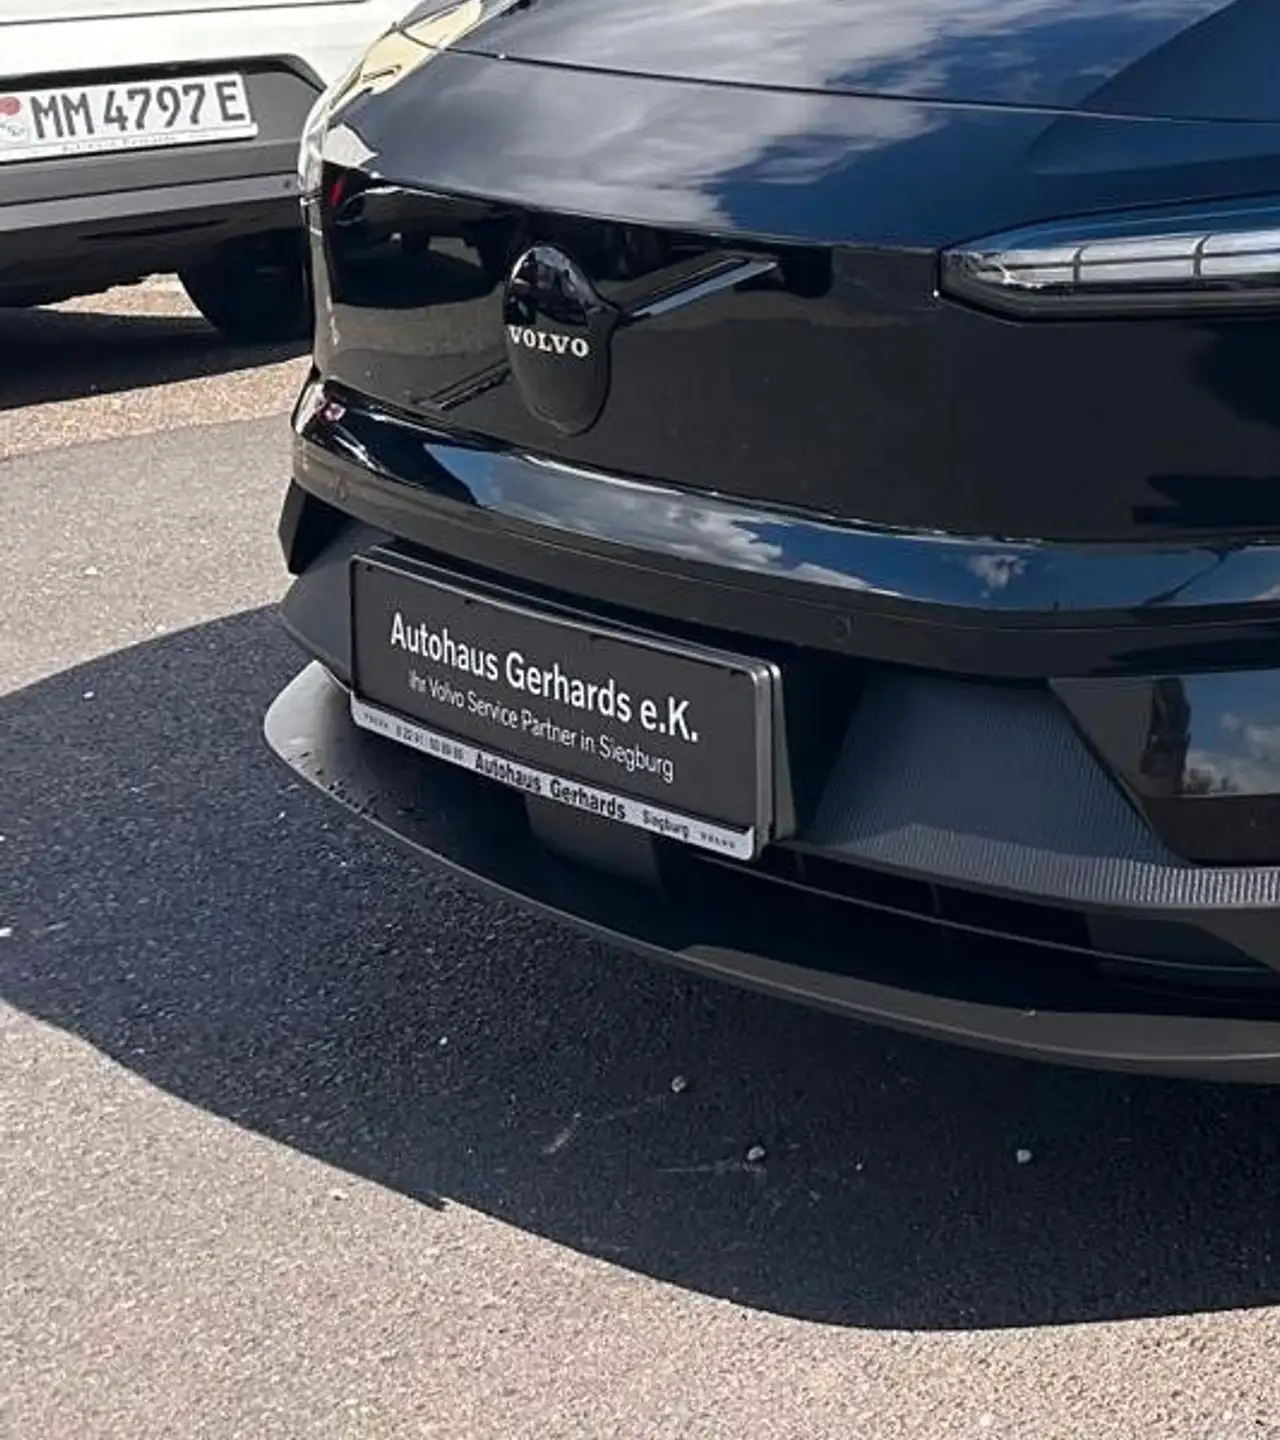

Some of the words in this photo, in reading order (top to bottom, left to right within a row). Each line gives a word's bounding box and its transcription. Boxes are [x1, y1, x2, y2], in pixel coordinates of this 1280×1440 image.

[30, 93, 94, 139] MM
[103, 83, 206, 131] 4797
[216, 81, 245, 122] E
[508, 325, 589, 357] VOLVO
[391, 612, 498, 681] Autohaus
[506, 651, 632, 723] Gerhards
[640, 696, 699, 742] e.K.
[428, 676, 464, 708] Volvo
[467, 690, 518, 728] Service
[521, 707, 577, 748] Partner
[581, 729, 595, 754] in
[600, 734, 674, 784] Siegburg
[475, 752, 542, 791] Autohaus
[551, 779, 626, 820] Gerhards
